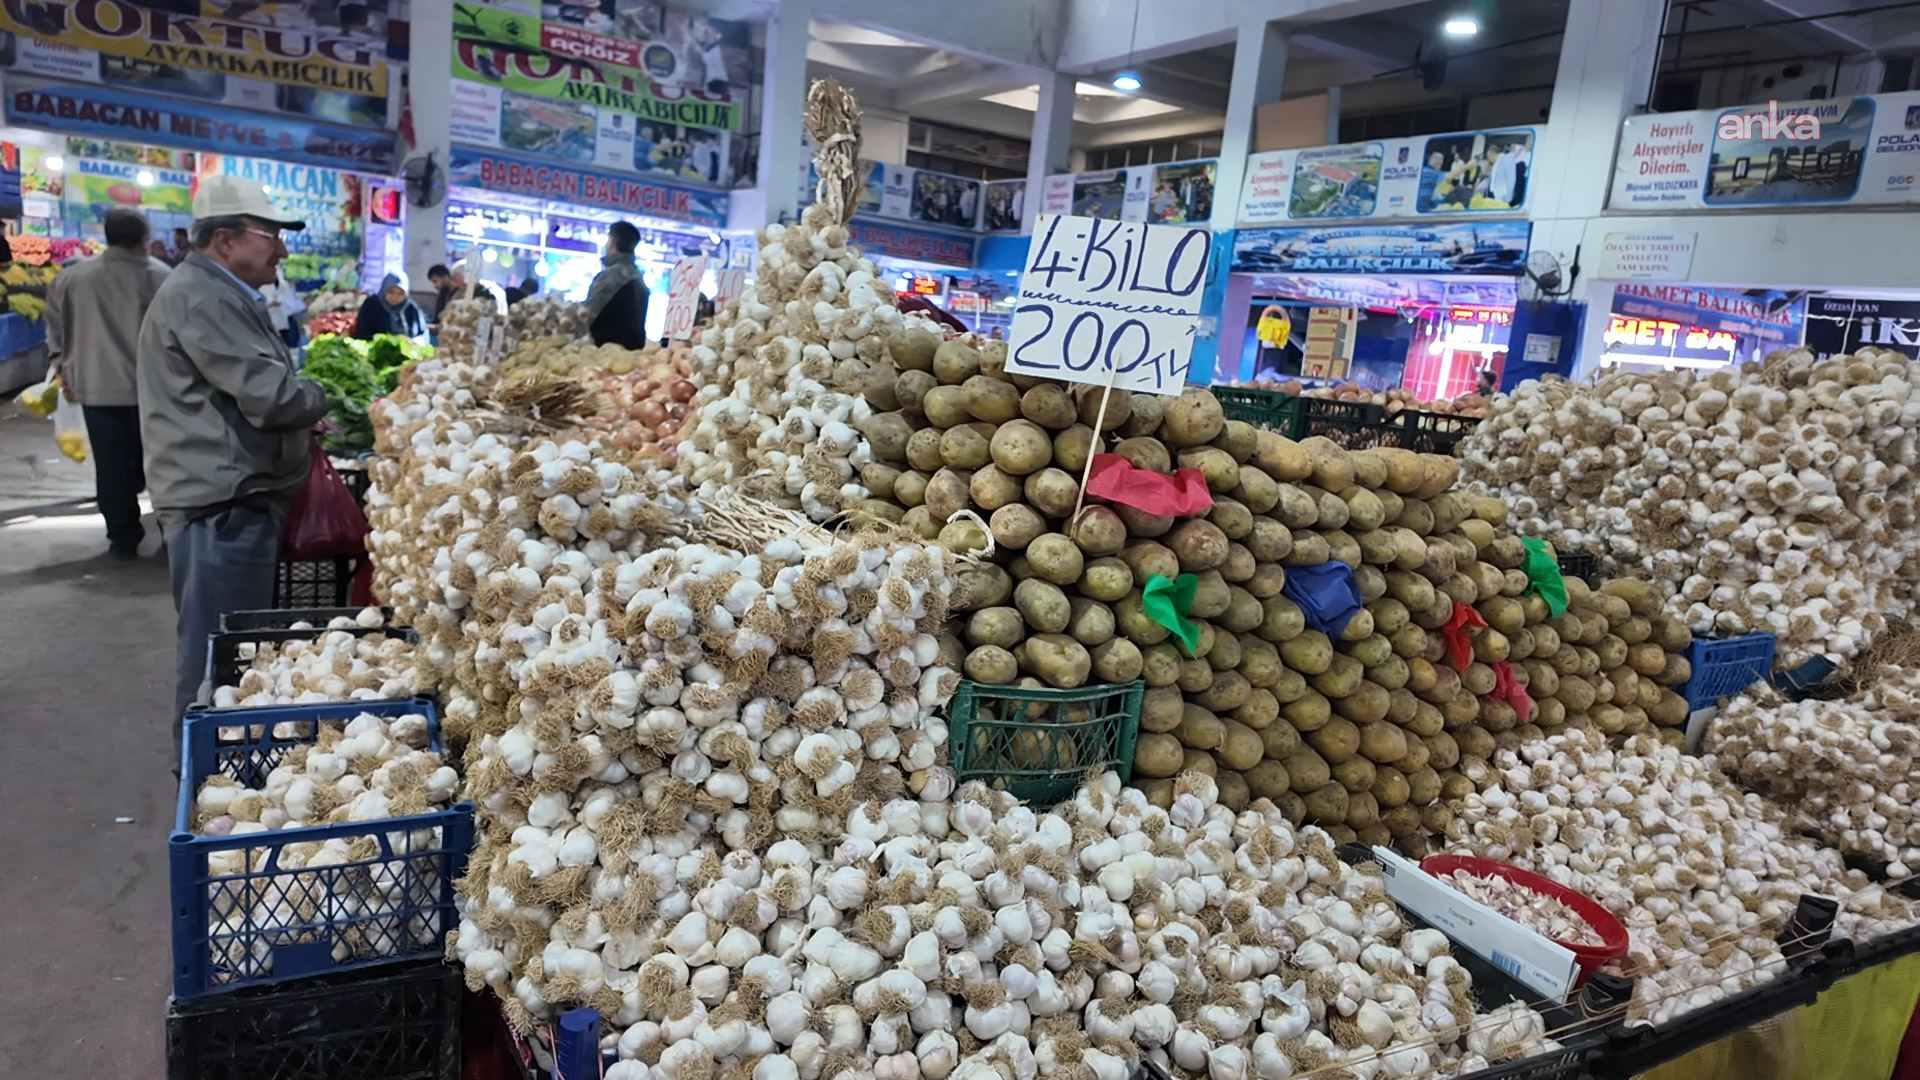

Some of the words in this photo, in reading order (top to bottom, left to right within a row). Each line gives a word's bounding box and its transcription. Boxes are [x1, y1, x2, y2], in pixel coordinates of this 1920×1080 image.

[14, 91, 160, 132] BABACAN
[170, 112, 267, 147] MEYVE
[1813, 104, 1838, 118] AVM
[1650, 120, 1694, 140] Hayırlı
[1632, 139, 1705, 160] Alışverişler
[479, 158, 578, 196] BABACAN
[1639, 159, 1690, 176] Dilerim.
